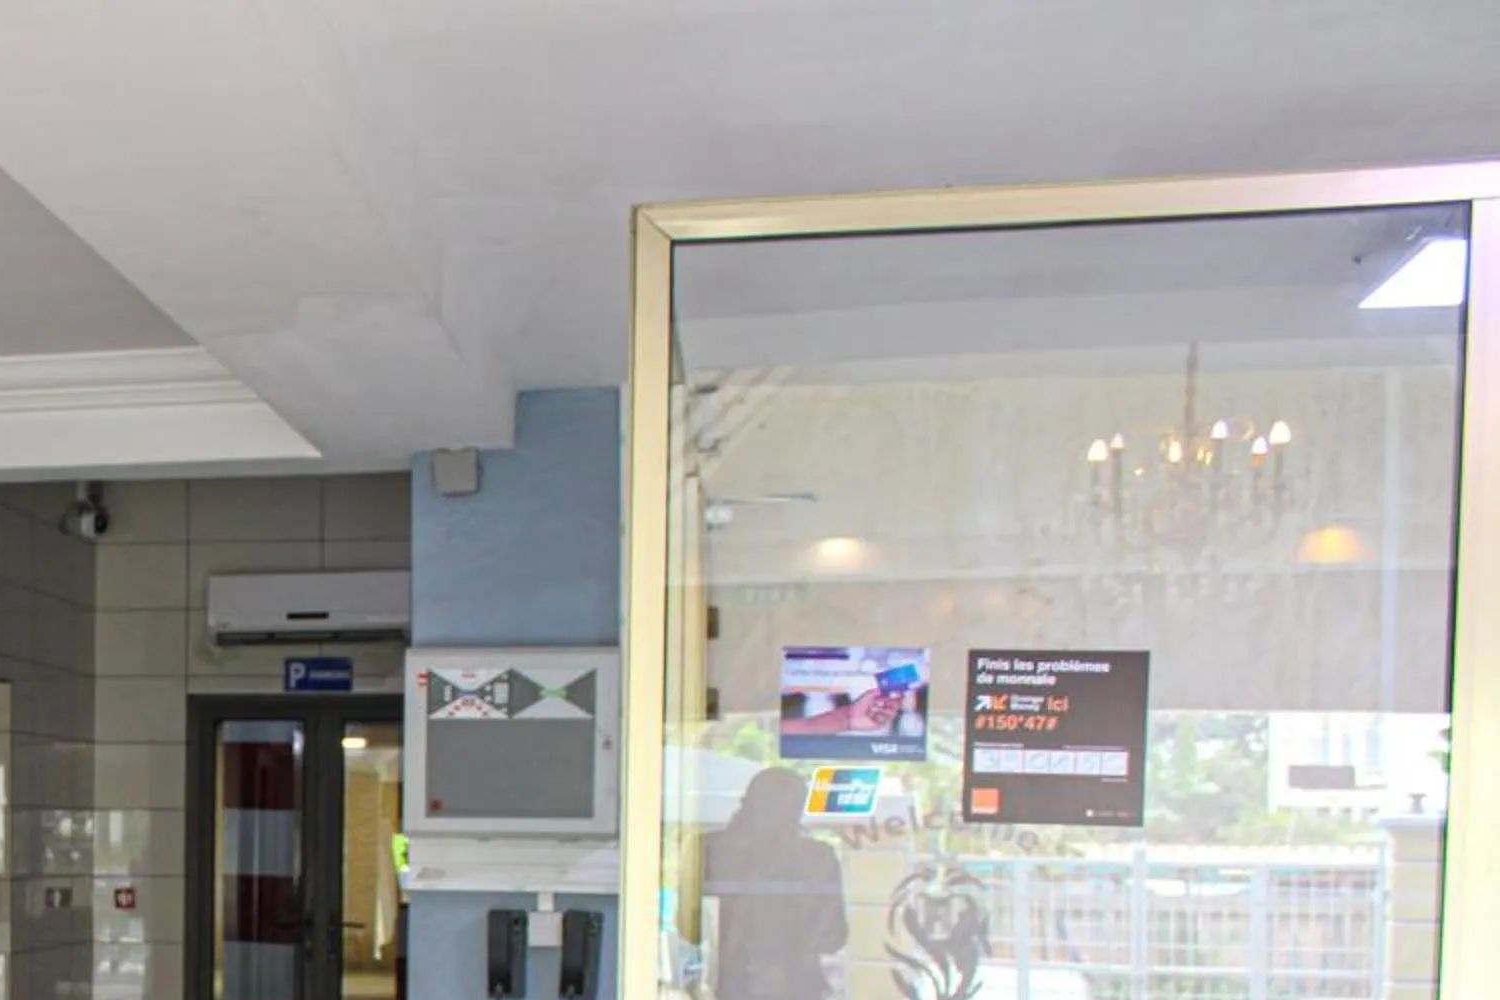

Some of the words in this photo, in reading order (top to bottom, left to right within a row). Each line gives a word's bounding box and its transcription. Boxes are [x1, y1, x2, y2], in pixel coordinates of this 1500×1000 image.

[976, 657, 1011, 671] Finis
[1013, 658, 1035, 671] les
[289, 662, 306, 688] P
[975, 672, 994, 685] de
[996, 674, 1057, 686] monnaie
